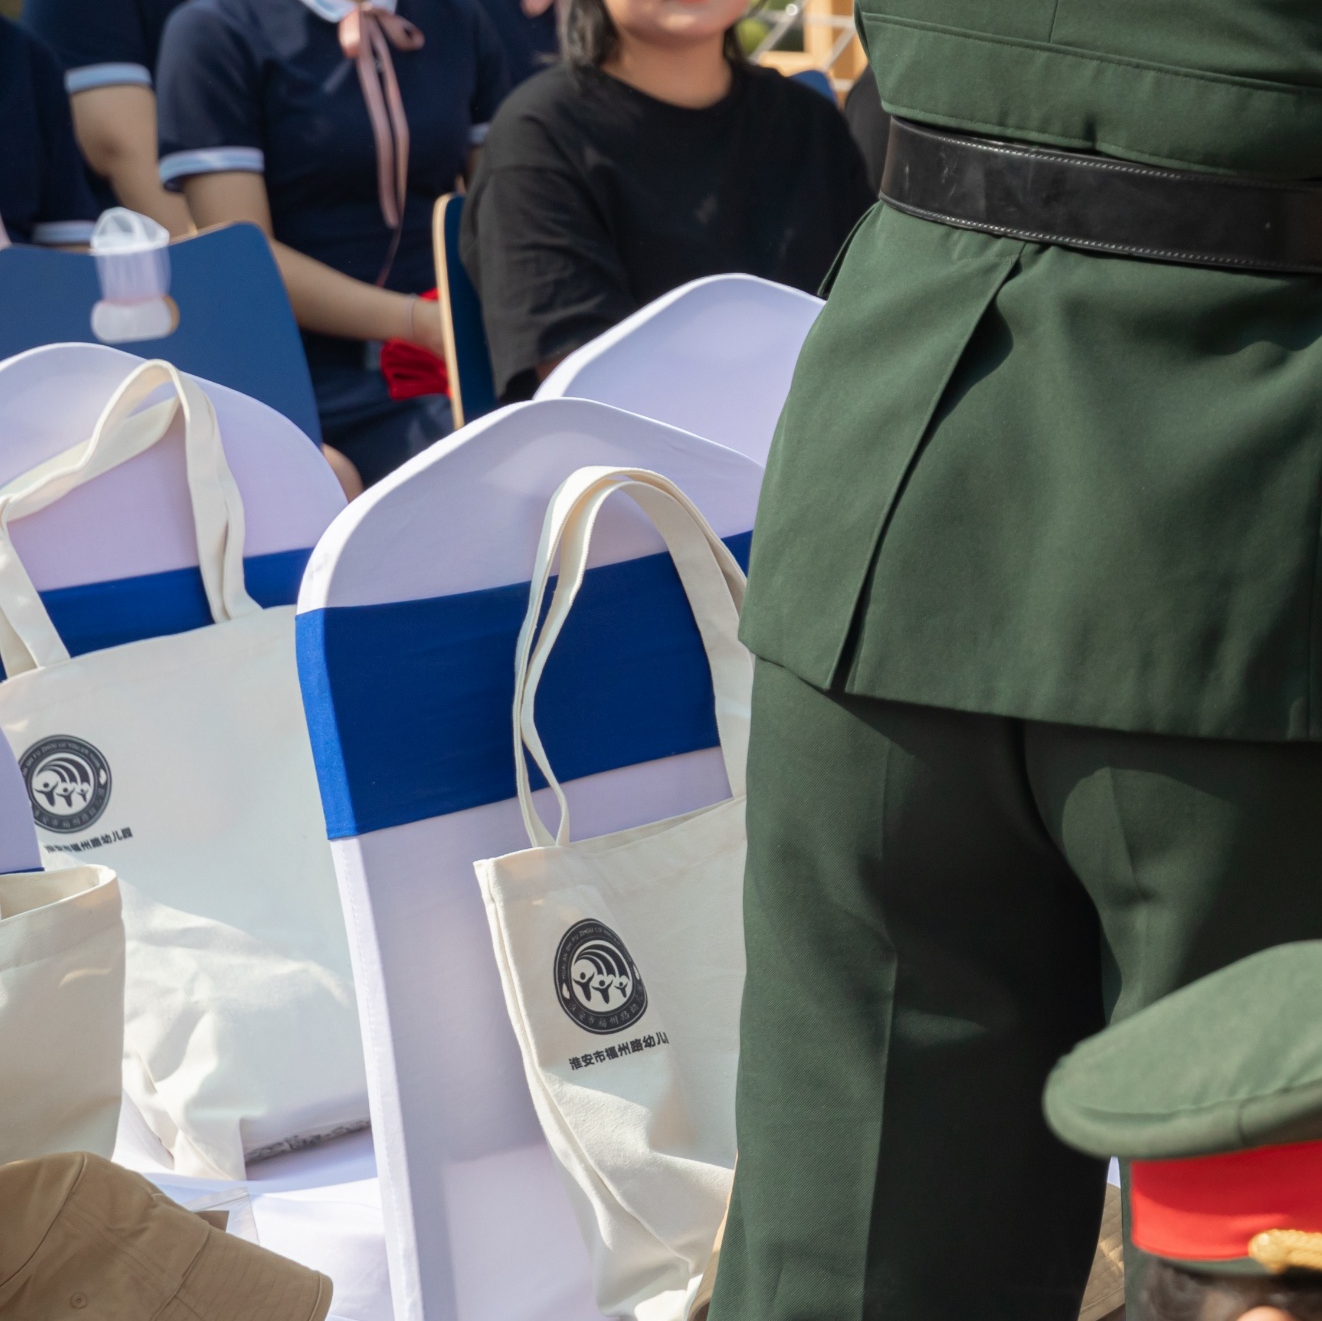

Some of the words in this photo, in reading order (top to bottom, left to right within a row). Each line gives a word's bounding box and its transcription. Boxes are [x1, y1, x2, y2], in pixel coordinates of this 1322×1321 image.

[569, 1031, 671, 1071] 淮安市福州路幼儿
